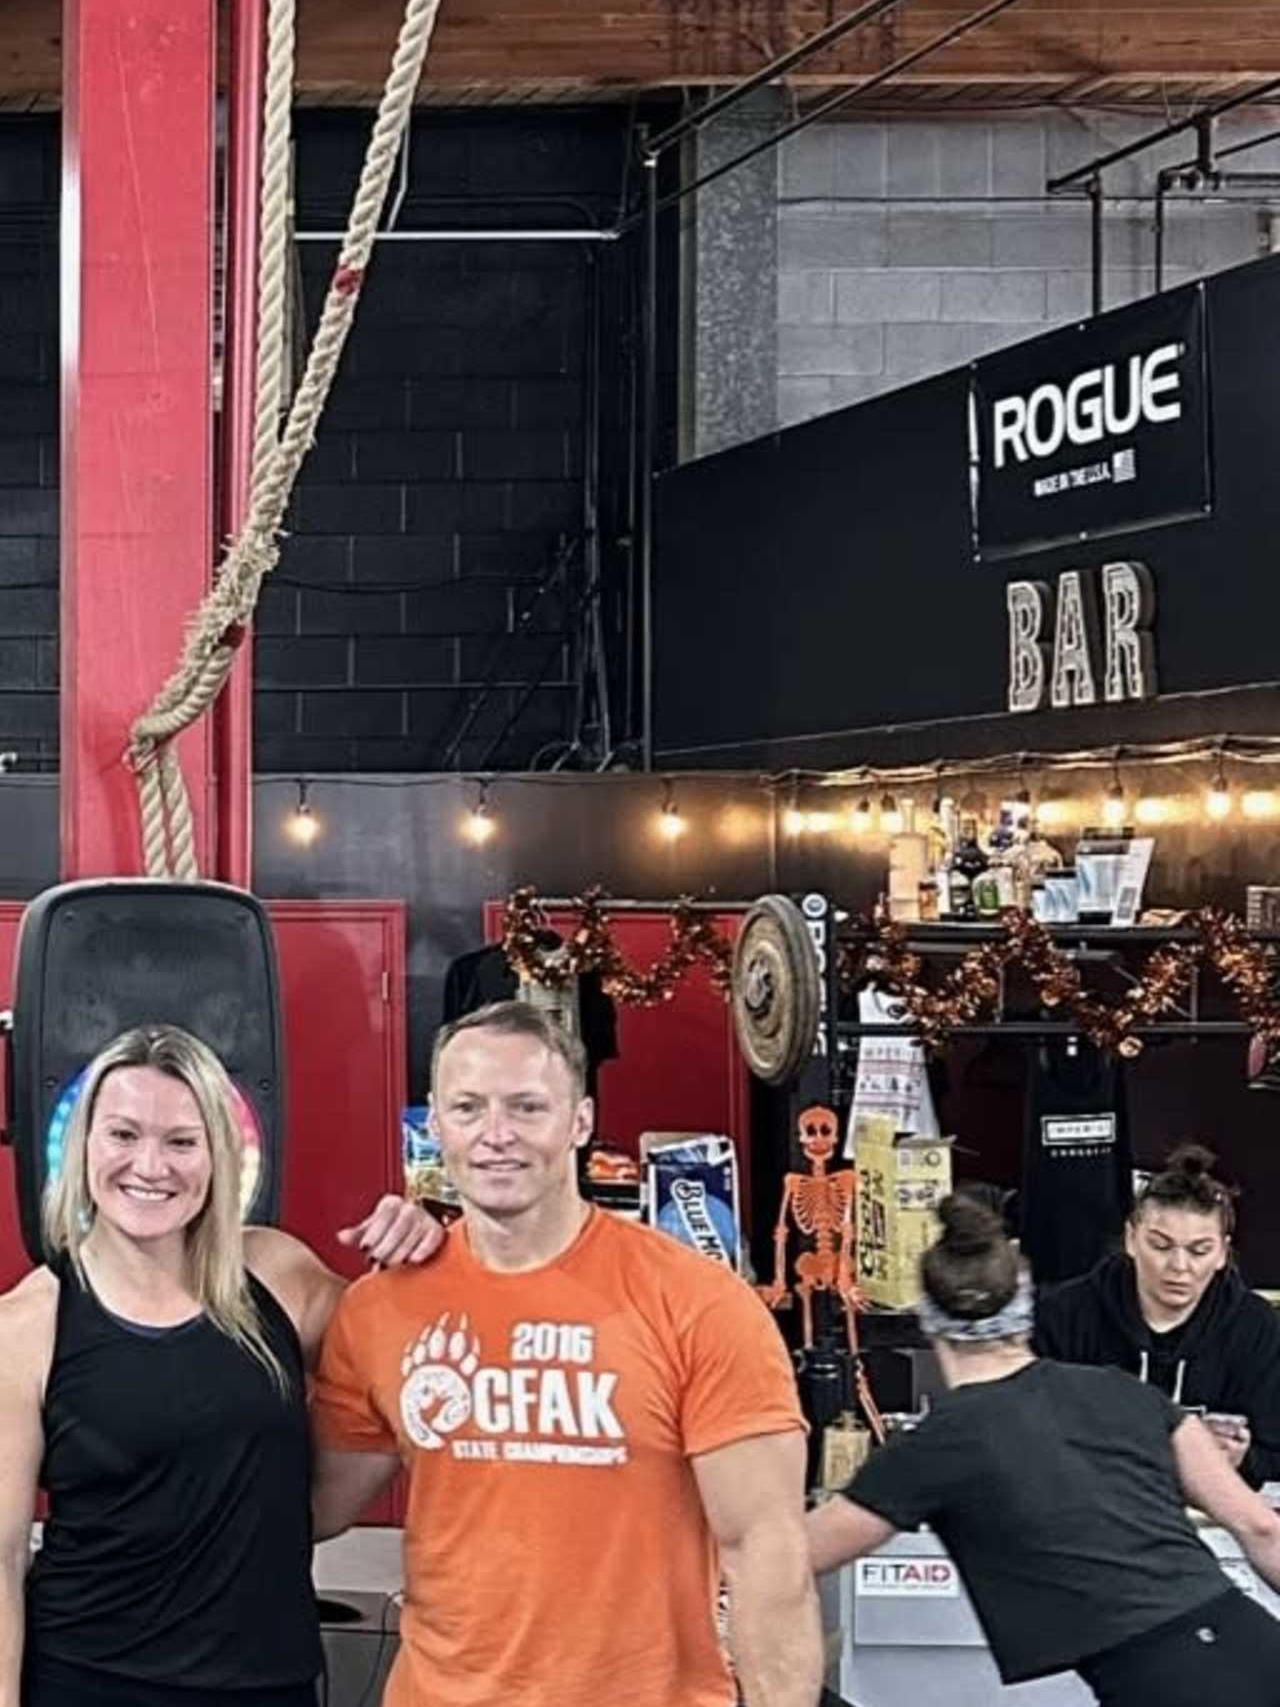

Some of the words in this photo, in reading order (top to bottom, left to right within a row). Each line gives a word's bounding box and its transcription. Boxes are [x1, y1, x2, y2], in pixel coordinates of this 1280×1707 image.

[993, 343, 1182, 469] ROGUE
[1006, 562, 1146, 713] BAR
[674, 1180, 711, 1233] BLUE
[511, 1322, 594, 1364] 2016
[472, 1367, 625, 1439] CFAK
[863, 1564, 951, 1583] FITAID
